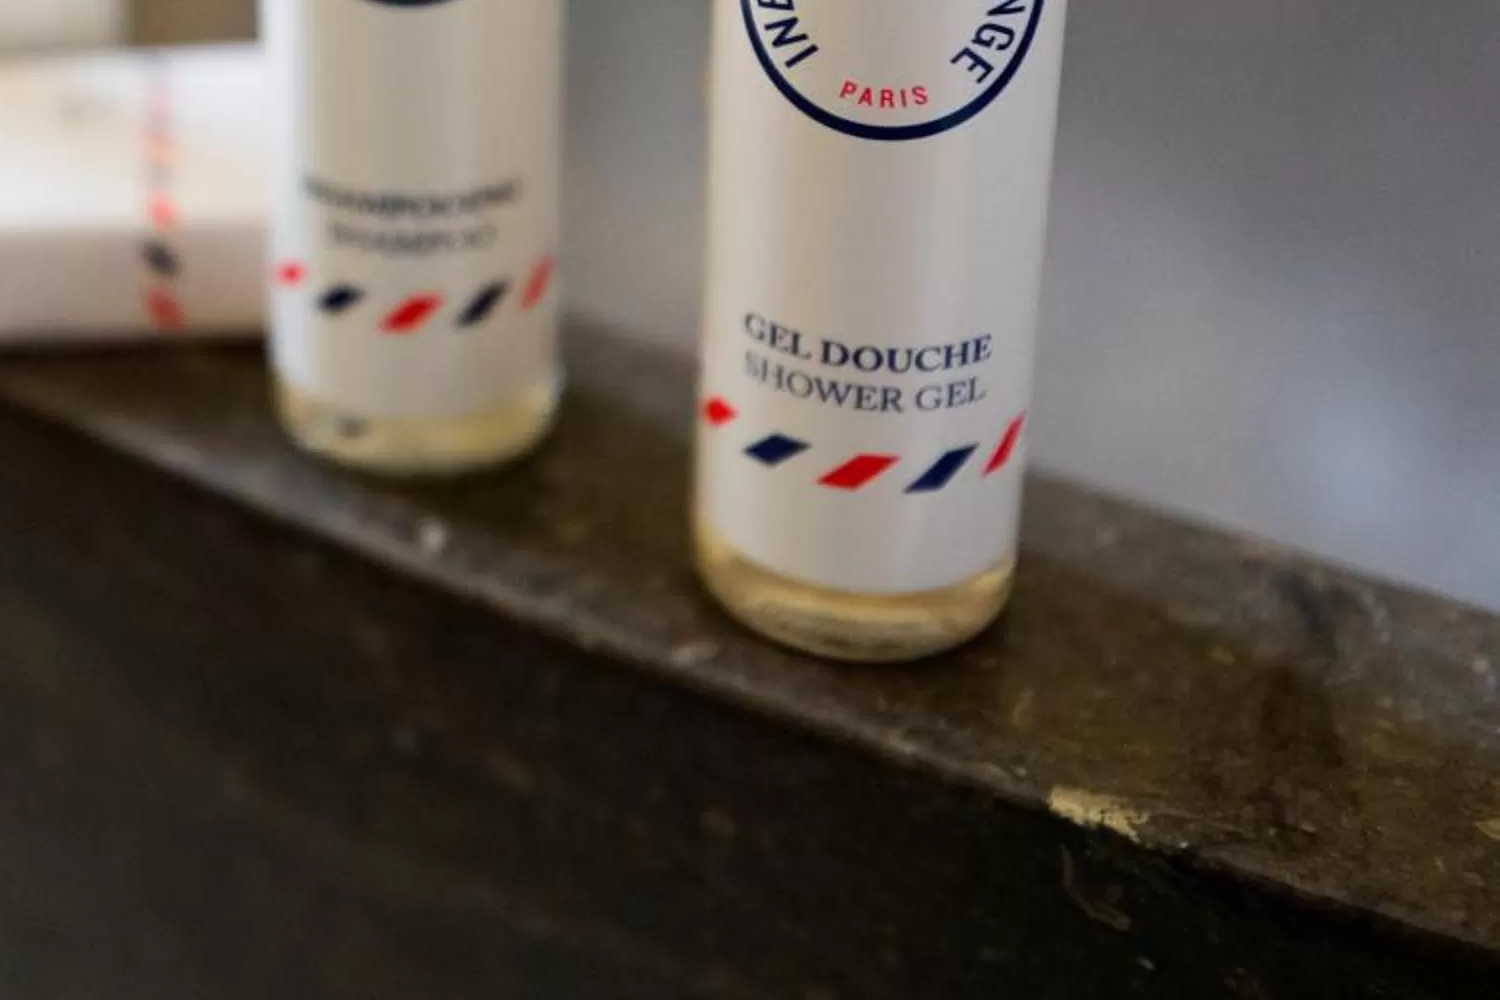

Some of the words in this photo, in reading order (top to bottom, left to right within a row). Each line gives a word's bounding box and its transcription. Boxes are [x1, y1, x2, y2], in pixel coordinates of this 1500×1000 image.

[838, 79, 929, 110] PARIS
[743, 312, 812, 360] GEL
[819, 333, 994, 374] DOUCHE
[744, 350, 905, 413] SHOWER
[914, 376, 988, 412] GEL
